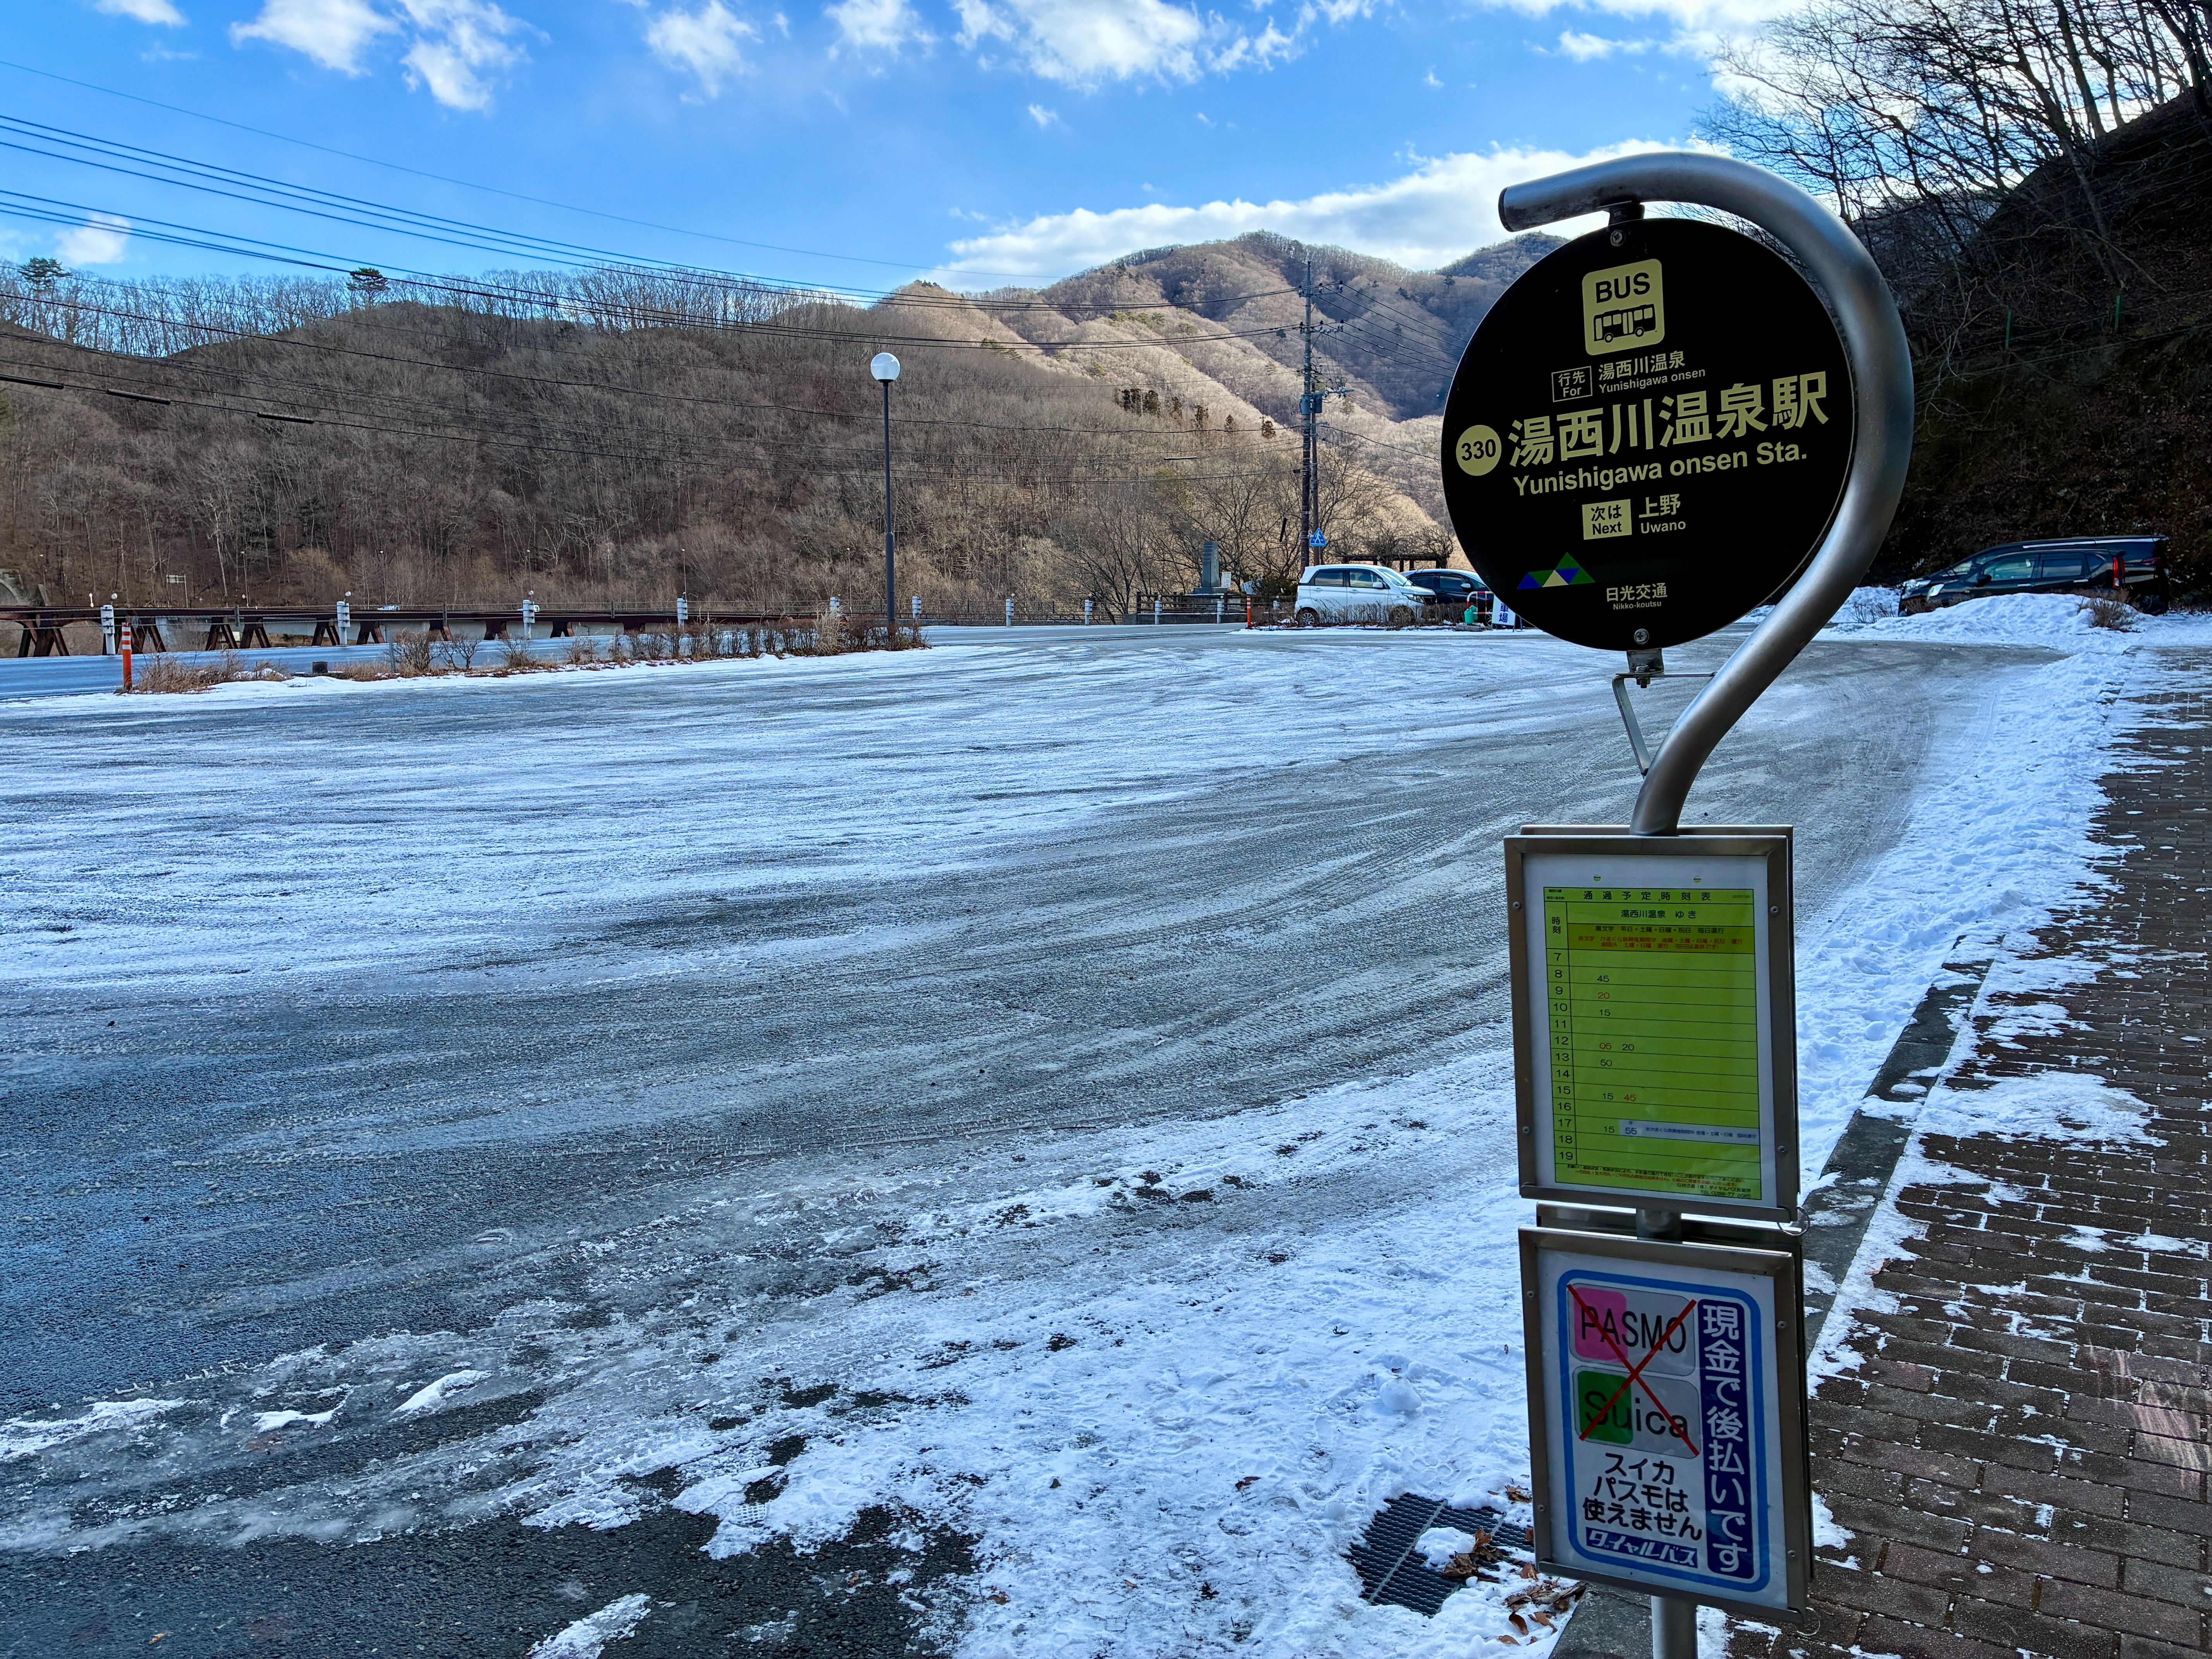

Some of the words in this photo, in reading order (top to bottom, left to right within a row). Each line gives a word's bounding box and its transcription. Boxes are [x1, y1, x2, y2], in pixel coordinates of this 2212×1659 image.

[1596, 272, 1650, 303] BUS
[1599, 350, 1685, 381] 湯西川温泉
[1558, 371, 1585, 387] 行先
[1599, 375, 1668, 393] Yunishigawa
[1671, 369, 1705, 382] onsen
[1563, 387, 1582, 397] For
[1508, 371, 1829, 467] 湯西川温泉駅
[1461, 438, 1496, 461] 330
[1513, 462, 1662, 496] Yunishigawa
[1670, 451, 1748, 475] onsen
[1756, 441, 1807, 465] Sta.
[1638, 494, 1681, 518] 上野
[1591, 505, 1622, 522] 次は
[1592, 521, 1622, 535] Next
[1641, 521, 1686, 534] Uwano
[1606, 582, 1668, 602] 日光交通
[1613, 601, 1662, 610] Nikko-koutsu
[1583, 890, 1711, 901] 通過予定時刻表
[1621, 909, 1666, 918] 湯西川温泉
[1554, 953, 1561, 961] 7
[1555, 970, 1562, 978] 8
[1556, 986, 1563, 994] 9
[1554, 1003, 1568, 1011] 10
[1555, 1020, 1566, 1028] 11
[1555, 1036, 1569, 1045] 12
[1556, 1053, 1569, 1061] 13
[1556, 1069, 1570, 1078] 14
[1557, 1086, 1571, 1094] 15
[1558, 1103, 1571, 1111] 16
[1558, 1119, 1572, 1127] 17
[1559, 1135, 1573, 1144] 18
[1559, 1152, 1573, 1160] 19
[1581, 1305, 1686, 1353] PASMO
[1585, 1390, 1688, 1438] Suica
[1703, 1304, 1748, 1573] 現金で後払いです
[1605, 1453, 1674, 1485] スイカ
[1593, 1476, 1688, 1513] パスモは
[1582, 1497, 1702, 1540] 使えません
